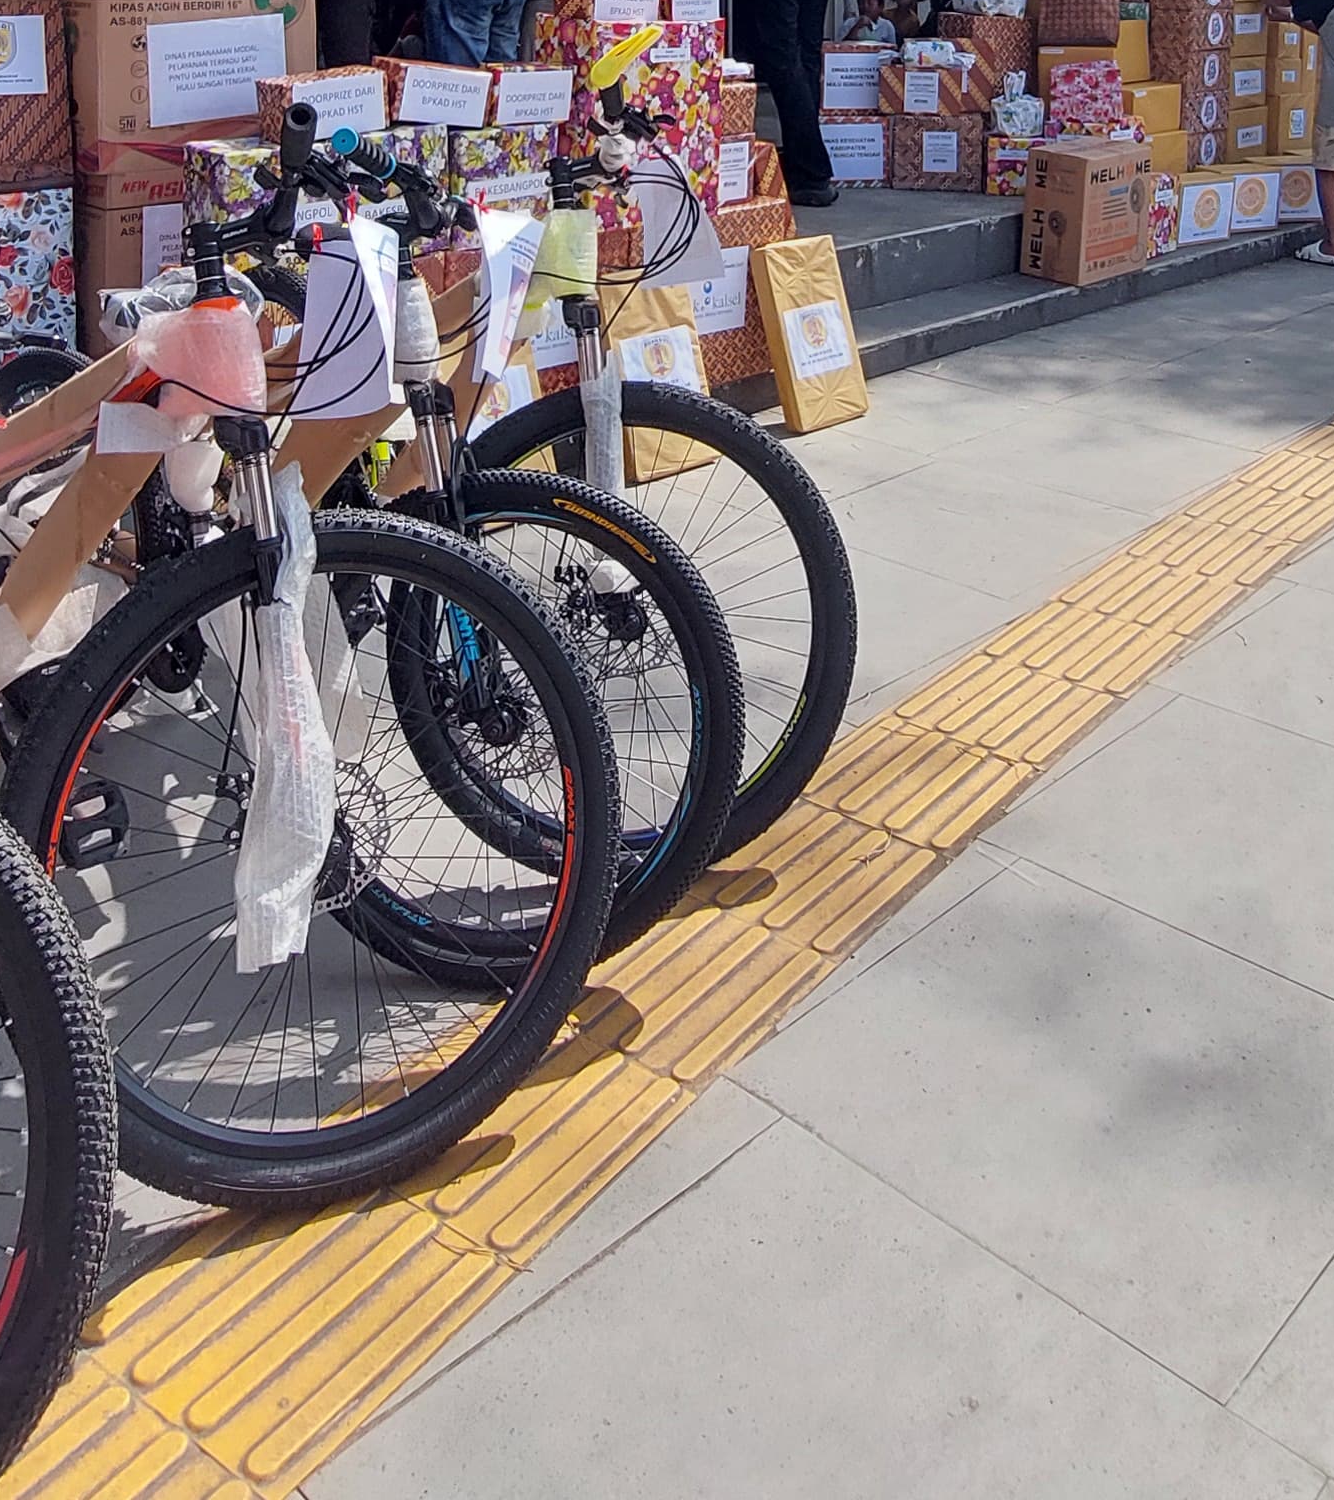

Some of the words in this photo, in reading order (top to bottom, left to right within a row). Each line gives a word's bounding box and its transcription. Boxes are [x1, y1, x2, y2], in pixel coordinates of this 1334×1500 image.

[110, 1, 144, 13] KIPAS
[146, 1, 182, 12] ANGIN
[183, 0, 224, 11] BERDIRI
[610, 6, 632, 16] BPKAD
[632, 7, 645, 16] HST
[110, 16, 148, 27] AS-881
[165, 50, 186, 62] DINAS
[187, 46, 233, 60] PENANAMAN
[168, 59, 209, 71] PELAYANAN
[209, 57, 241, 69] TERPADU
[241, 54, 258, 64] SATU
[168, 72, 191, 83] PINTU
[191, 70, 208, 81] DAN
[207, 68, 237, 79] TENAGA
[176, 82, 195, 92] HULU
[196, 79, 224, 90] SUNGAI
[225, 76, 252, 88] TENGAH
[412, 78, 460, 94] DOORPRIZE
[461, 83, 481, 95] DARI
[301, 88, 352, 105] DOORPRIZE
[353, 85, 376, 98] DARI
[505, 93, 547, 104] DOORPRIZE
[547, 92, 566, 103] DARI
[347, 104, 364, 116] HST
[422, 96, 450, 109] BPKAD
[450, 98, 467, 110] HST
[514, 107, 539, 118] BPKAD
[539, 106, 554, 117] HST
[121, 179, 150, 193] NEW
[297, 205, 333, 222] NGPOL
